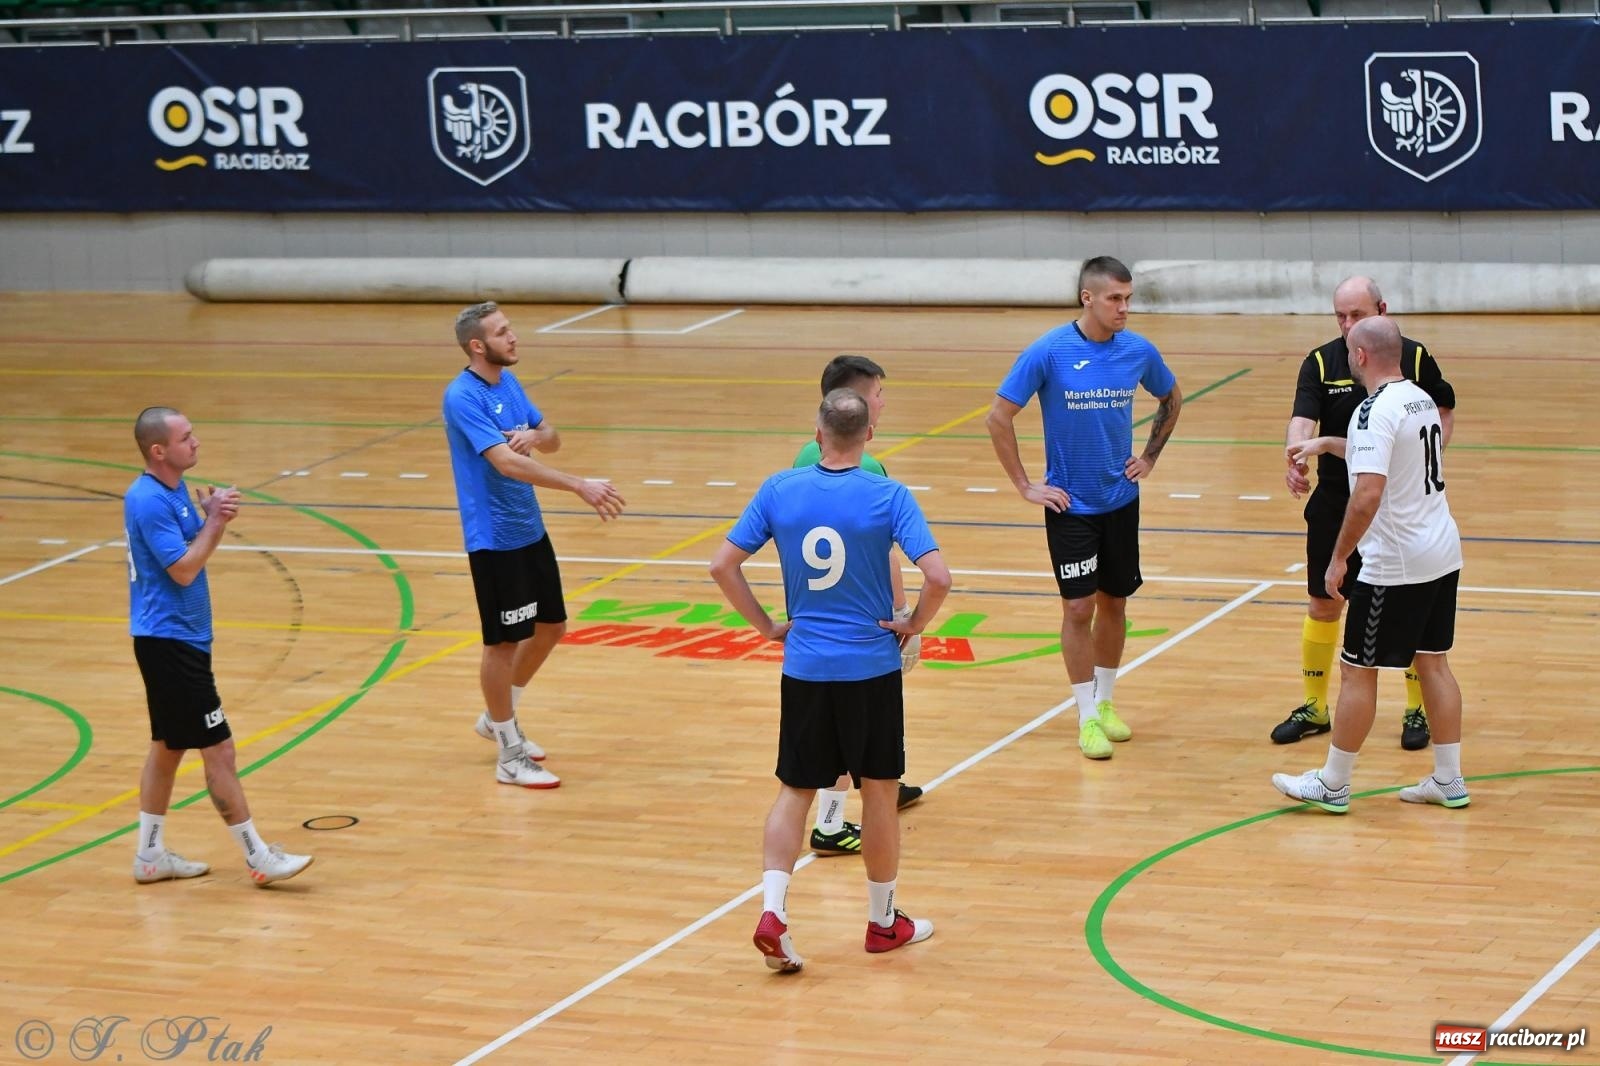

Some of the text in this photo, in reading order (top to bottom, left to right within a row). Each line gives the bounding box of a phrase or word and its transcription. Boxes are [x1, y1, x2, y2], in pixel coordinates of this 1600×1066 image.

[585, 81, 891, 149] RACIBÓRZ
[214, 150, 310, 170] RACIBÓRZ
[1106, 140, 1220, 165] RACIBÓRZ
[1067, 401, 1109, 410] Metallbau
[1419, 423, 1445, 496] 10
[801, 525, 846, 591] 9
[1060, 562, 1081, 580] LSM
